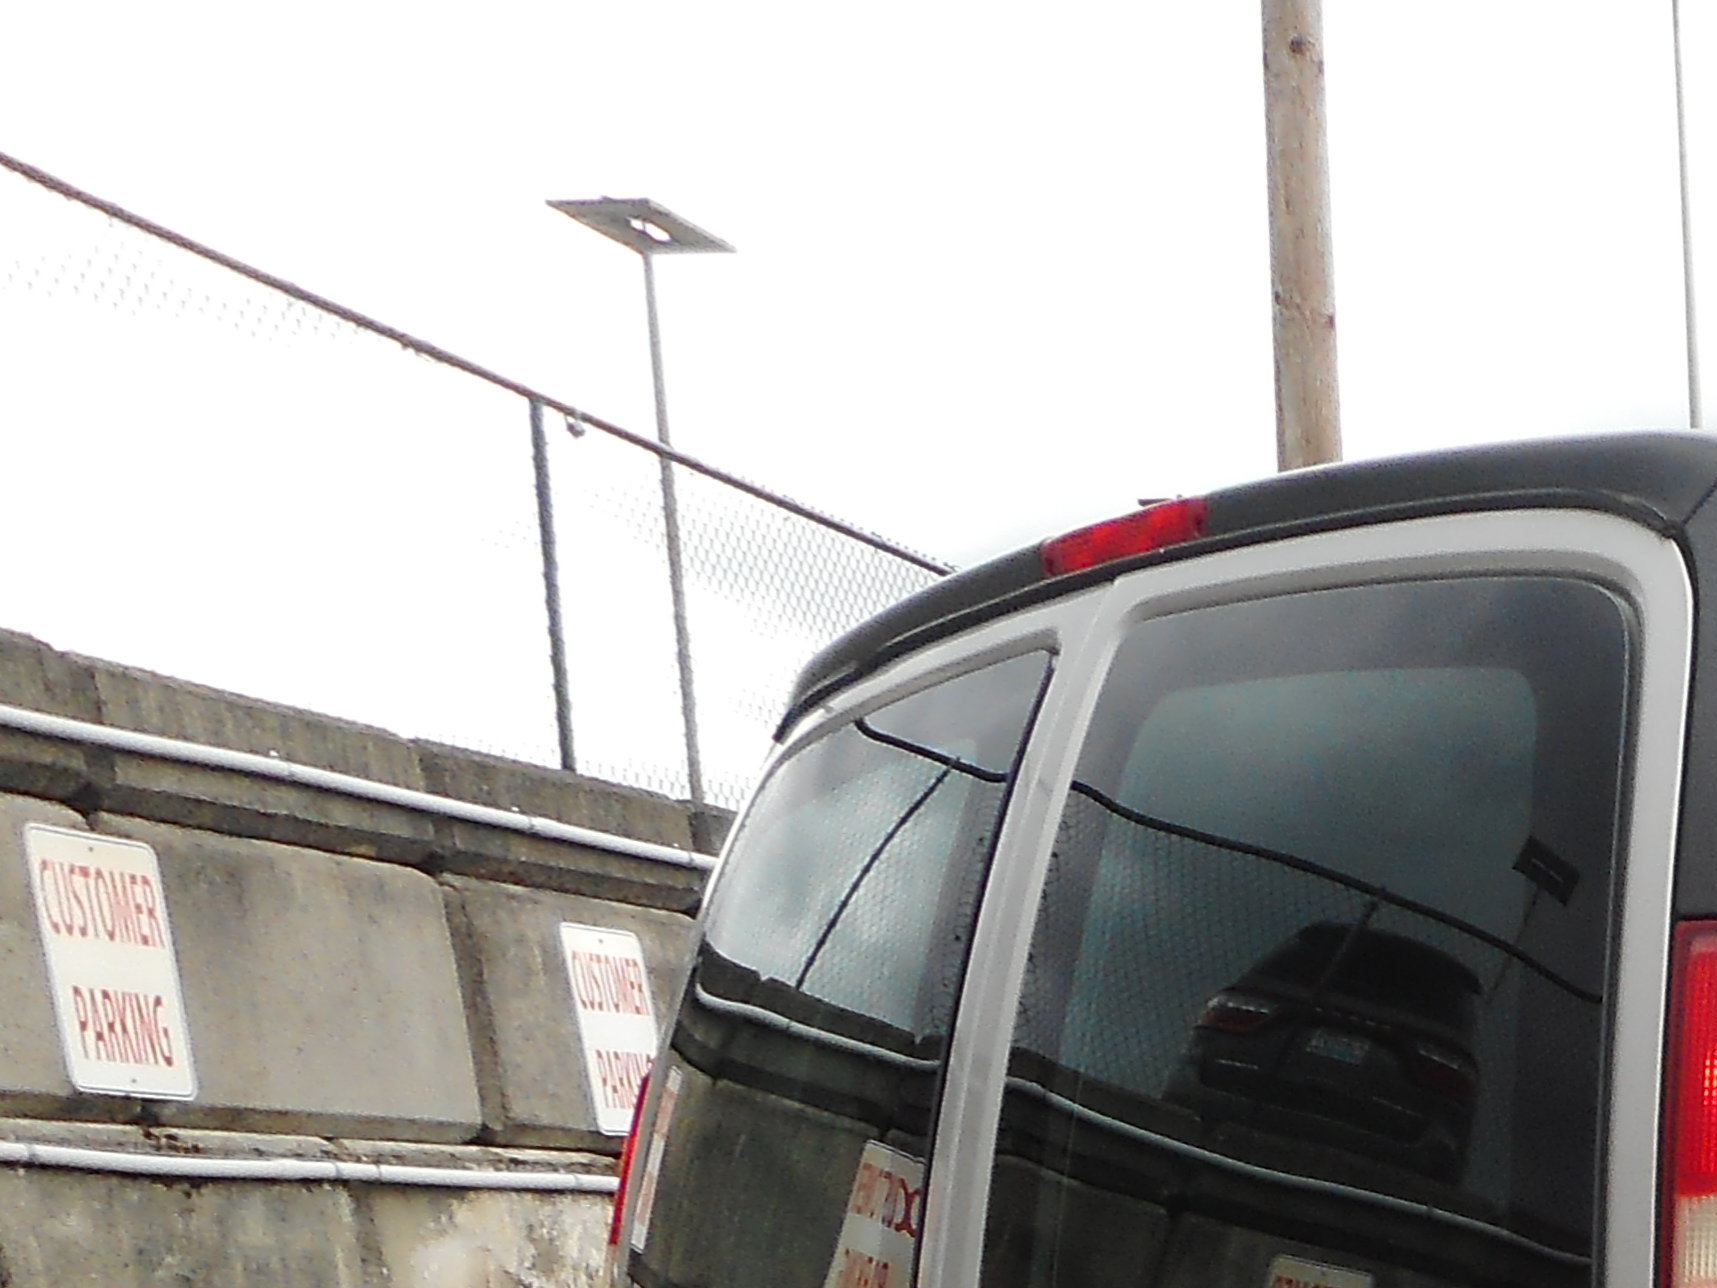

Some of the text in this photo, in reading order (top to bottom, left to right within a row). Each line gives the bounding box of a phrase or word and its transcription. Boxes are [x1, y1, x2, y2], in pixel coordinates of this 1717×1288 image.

[40, 858, 166, 948] CUSTOMER
[571, 950, 650, 1016] CUSTOMER
[72, 985, 174, 1067] PARKING
